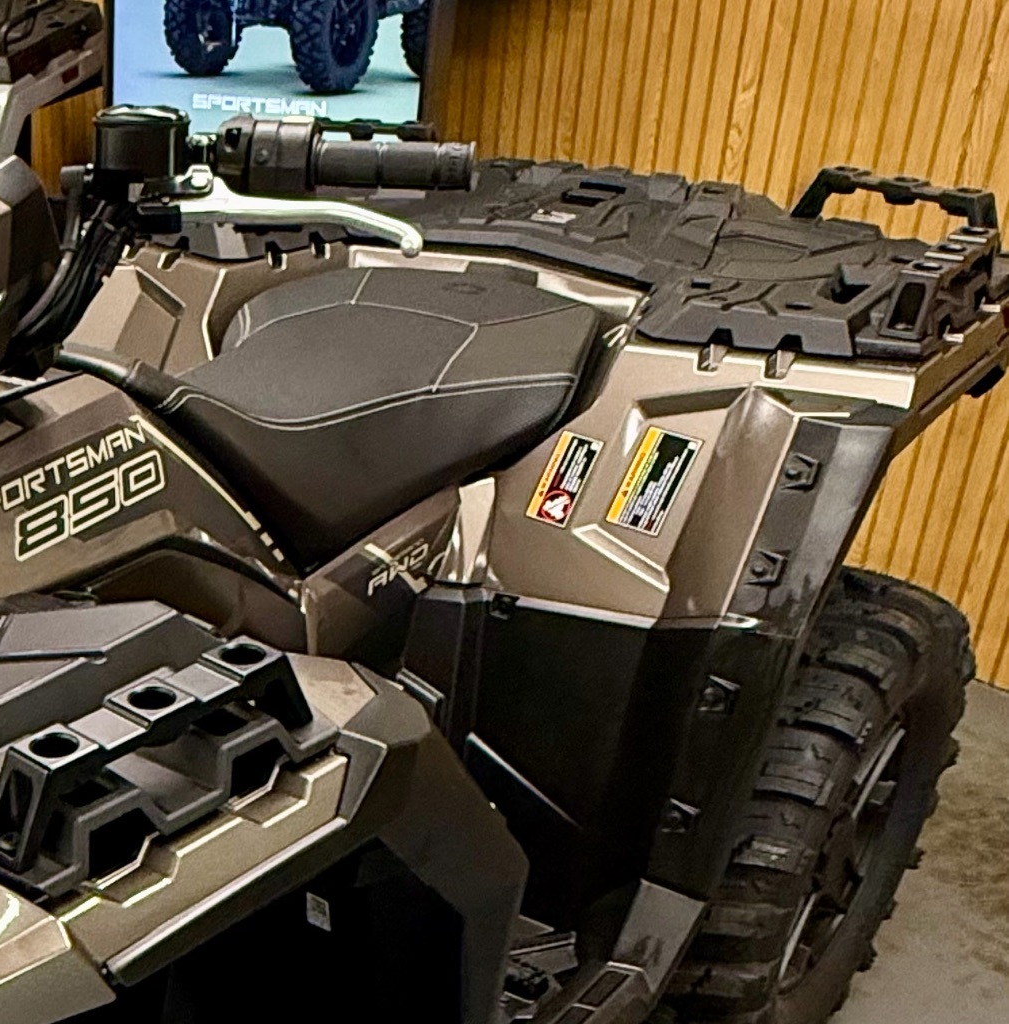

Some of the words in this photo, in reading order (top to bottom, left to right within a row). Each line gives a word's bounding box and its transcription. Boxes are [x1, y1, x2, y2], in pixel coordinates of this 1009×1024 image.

[192, 93, 328, 117] SPORTSMAN
[15, 449, 166, 562] 850
[367, 543, 429, 597] AWD
